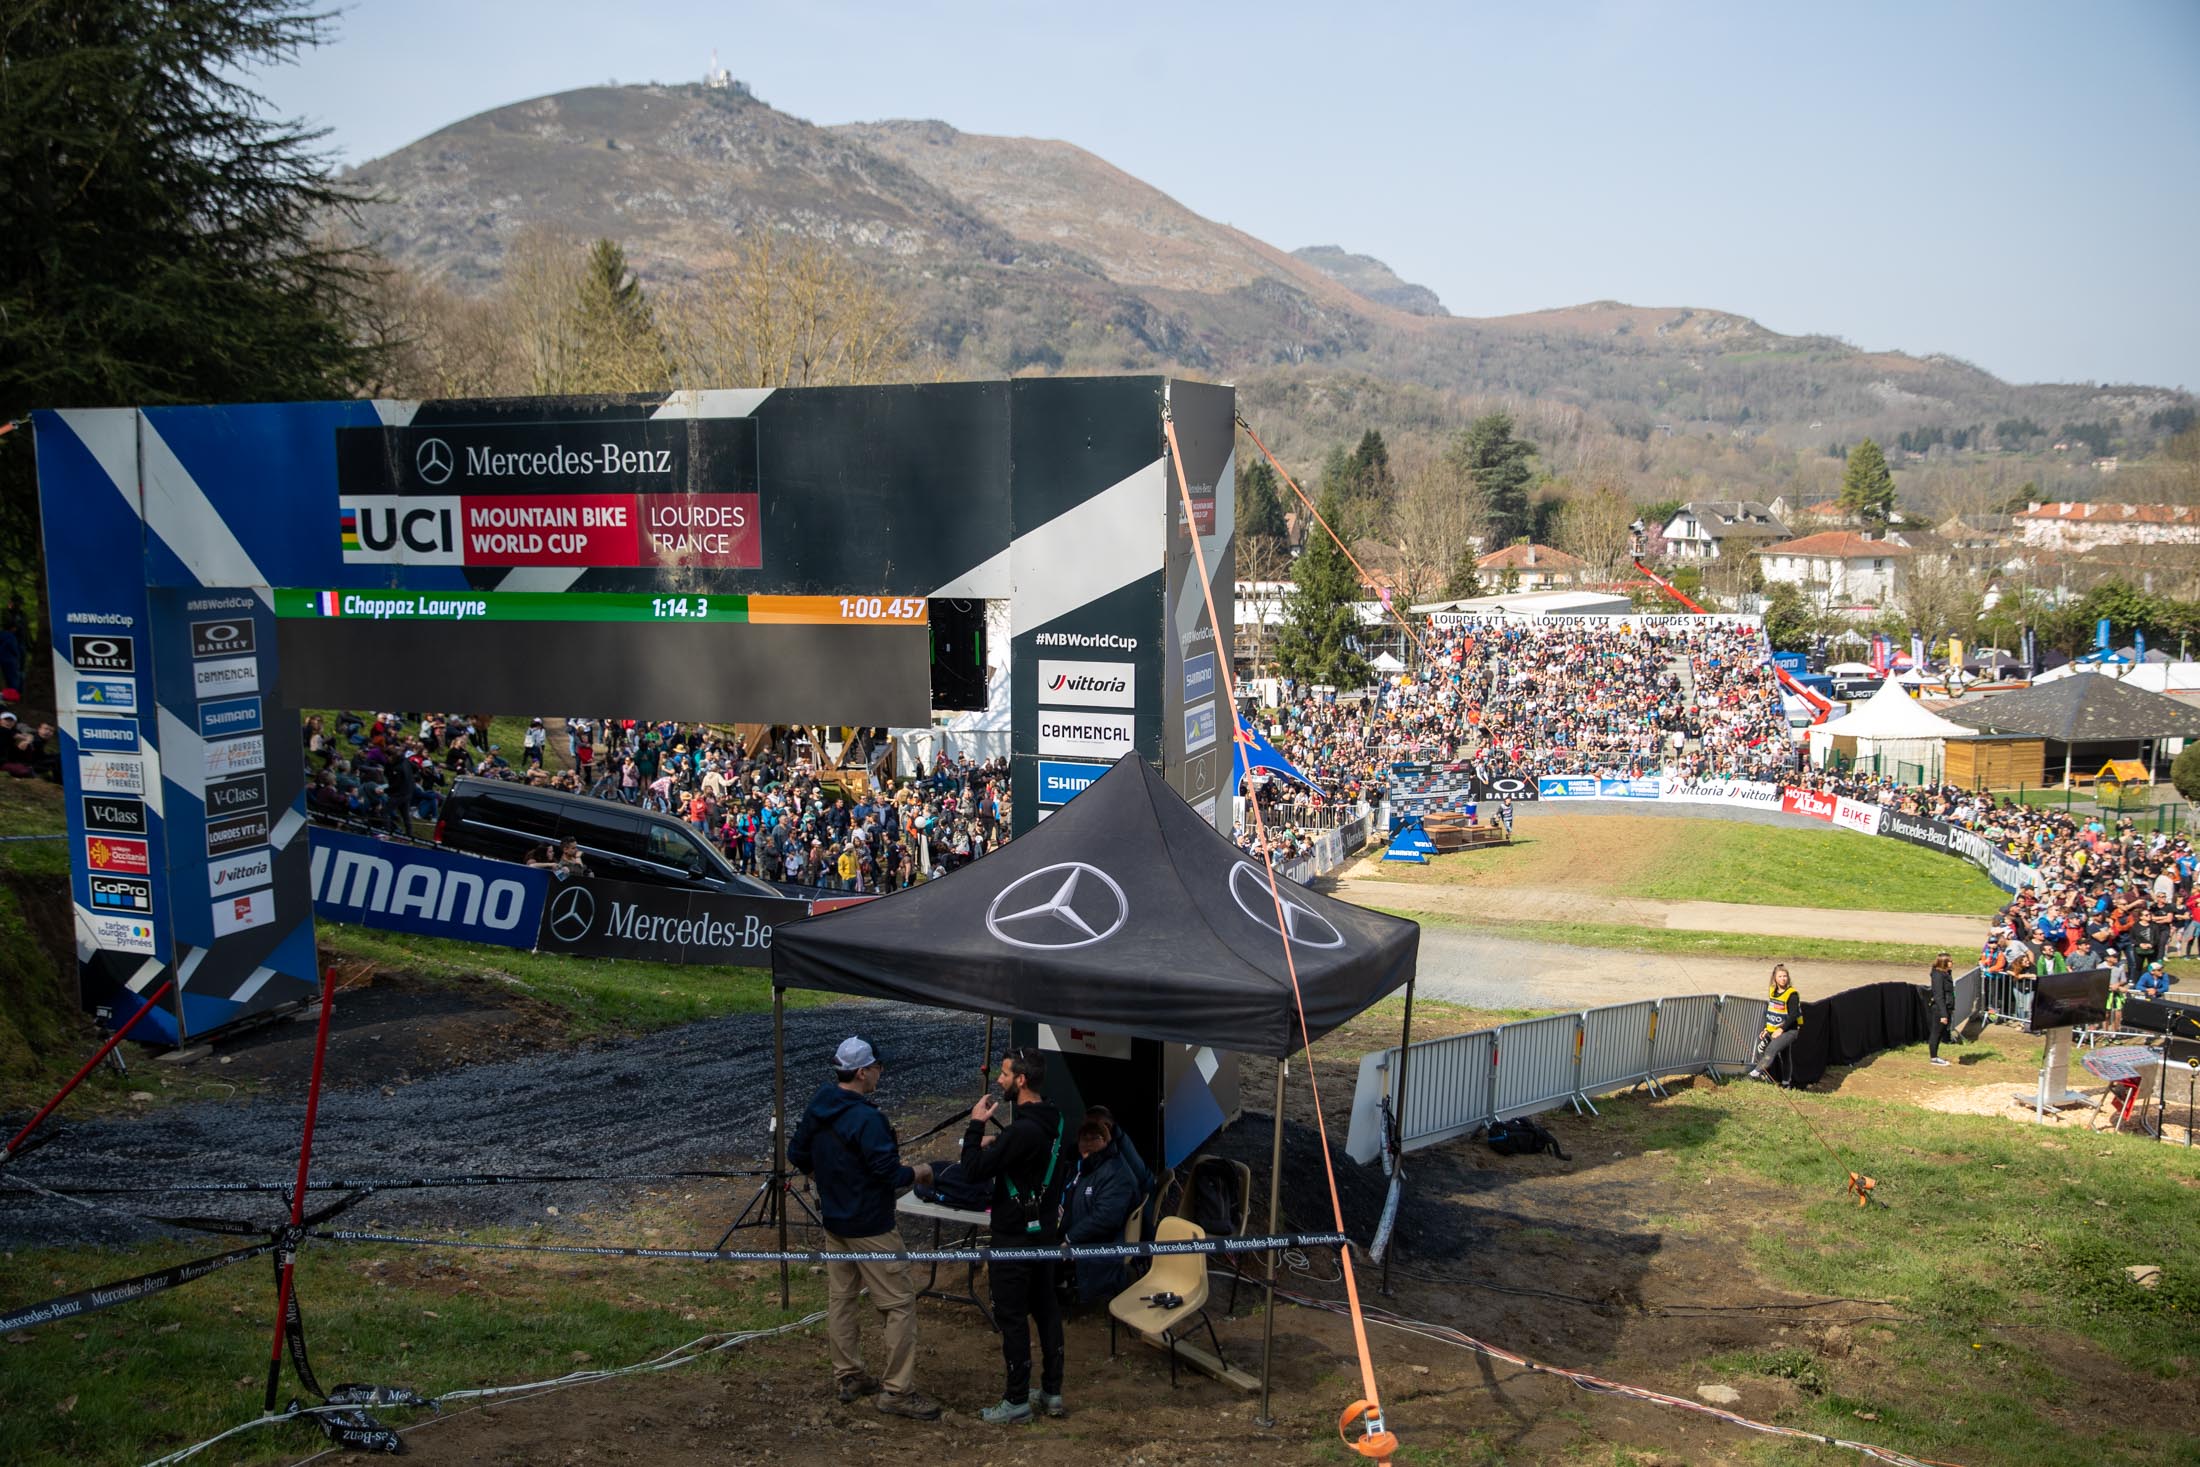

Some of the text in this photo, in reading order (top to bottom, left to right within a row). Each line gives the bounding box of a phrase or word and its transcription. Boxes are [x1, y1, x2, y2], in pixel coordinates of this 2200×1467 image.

[466, 442, 671, 476] Mercedes-Benz
[471, 507, 627, 528] MOUNTAIN BIKE
[651, 507, 745, 528] LOURDES
[360, 508, 453, 552] UCI
[471, 534, 588, 554] WORLD CUP
[651, 533, 730, 554] FRANCE
[187, 598, 254, 611] #MBWorldCup
[344, 595, 487, 620] Chappaz Lauryne
[652, 597, 708, 617] 1:14.3
[839, 598, 925, 618] 1:00.457
[67, 612, 133, 628] #MBWorldCup
[1434, 614, 1482, 625] LOURDES
[1537, 616, 1586, 626] LOURDES
[1640, 616, 1690, 626] LOURDES
[198, 640, 248, 652] OAKLEY
[1036, 633, 1138, 651] #MBWorldCup
[77, 656, 128, 667] OAKLEY
[197, 667, 255, 684] COMMENCAL
[1067, 675, 1126, 692] vittoria
[1186, 667, 1212, 687] SHIMANO
[205, 709, 256, 725] SHIMANO
[82, 728, 134, 741] SHIMANO
[1042, 724, 1131, 742] COMMENCAL
[228, 740, 262, 752] LOURDES
[214, 786, 259, 806] V-Class
[1486, 792, 1534, 800] OAKLEY
[1680, 785, 1724, 797] vittoria
[92, 806, 138, 823] V-Class
[1794, 799, 1832, 816] ALBA
[1842, 808, 1872, 825] BIKE
[209, 824, 256, 842] LOURDES VTT
[1891, 818, 1947, 846] Mercedes-Benz
[1388, 849, 1420, 857] SHIMANO
[227, 861, 267, 881] vittoria
[94, 881, 147, 896] GoPro
[604, 901, 773, 949] Mercedes-Be
[1071, 1244, 1141, 1257] Mercedes-Benz
[1149, 1240, 1217, 1254] Mercedes-Benz
[1224, 1236, 1290, 1250] Mercedes-Benz
[637, 1248, 720, 1258] Mercedes-Benz
[730, 1250, 810, 1259] Mercedes-Benz
[820, 1250, 897, 1260] Mercedes-Benz
[907, 1249, 981, 1259] Mercedes-Benz
[989, 1247, 1063, 1258] Mercedes-Benz
[91, 1274, 169, 1307] Mercedes-Benz
